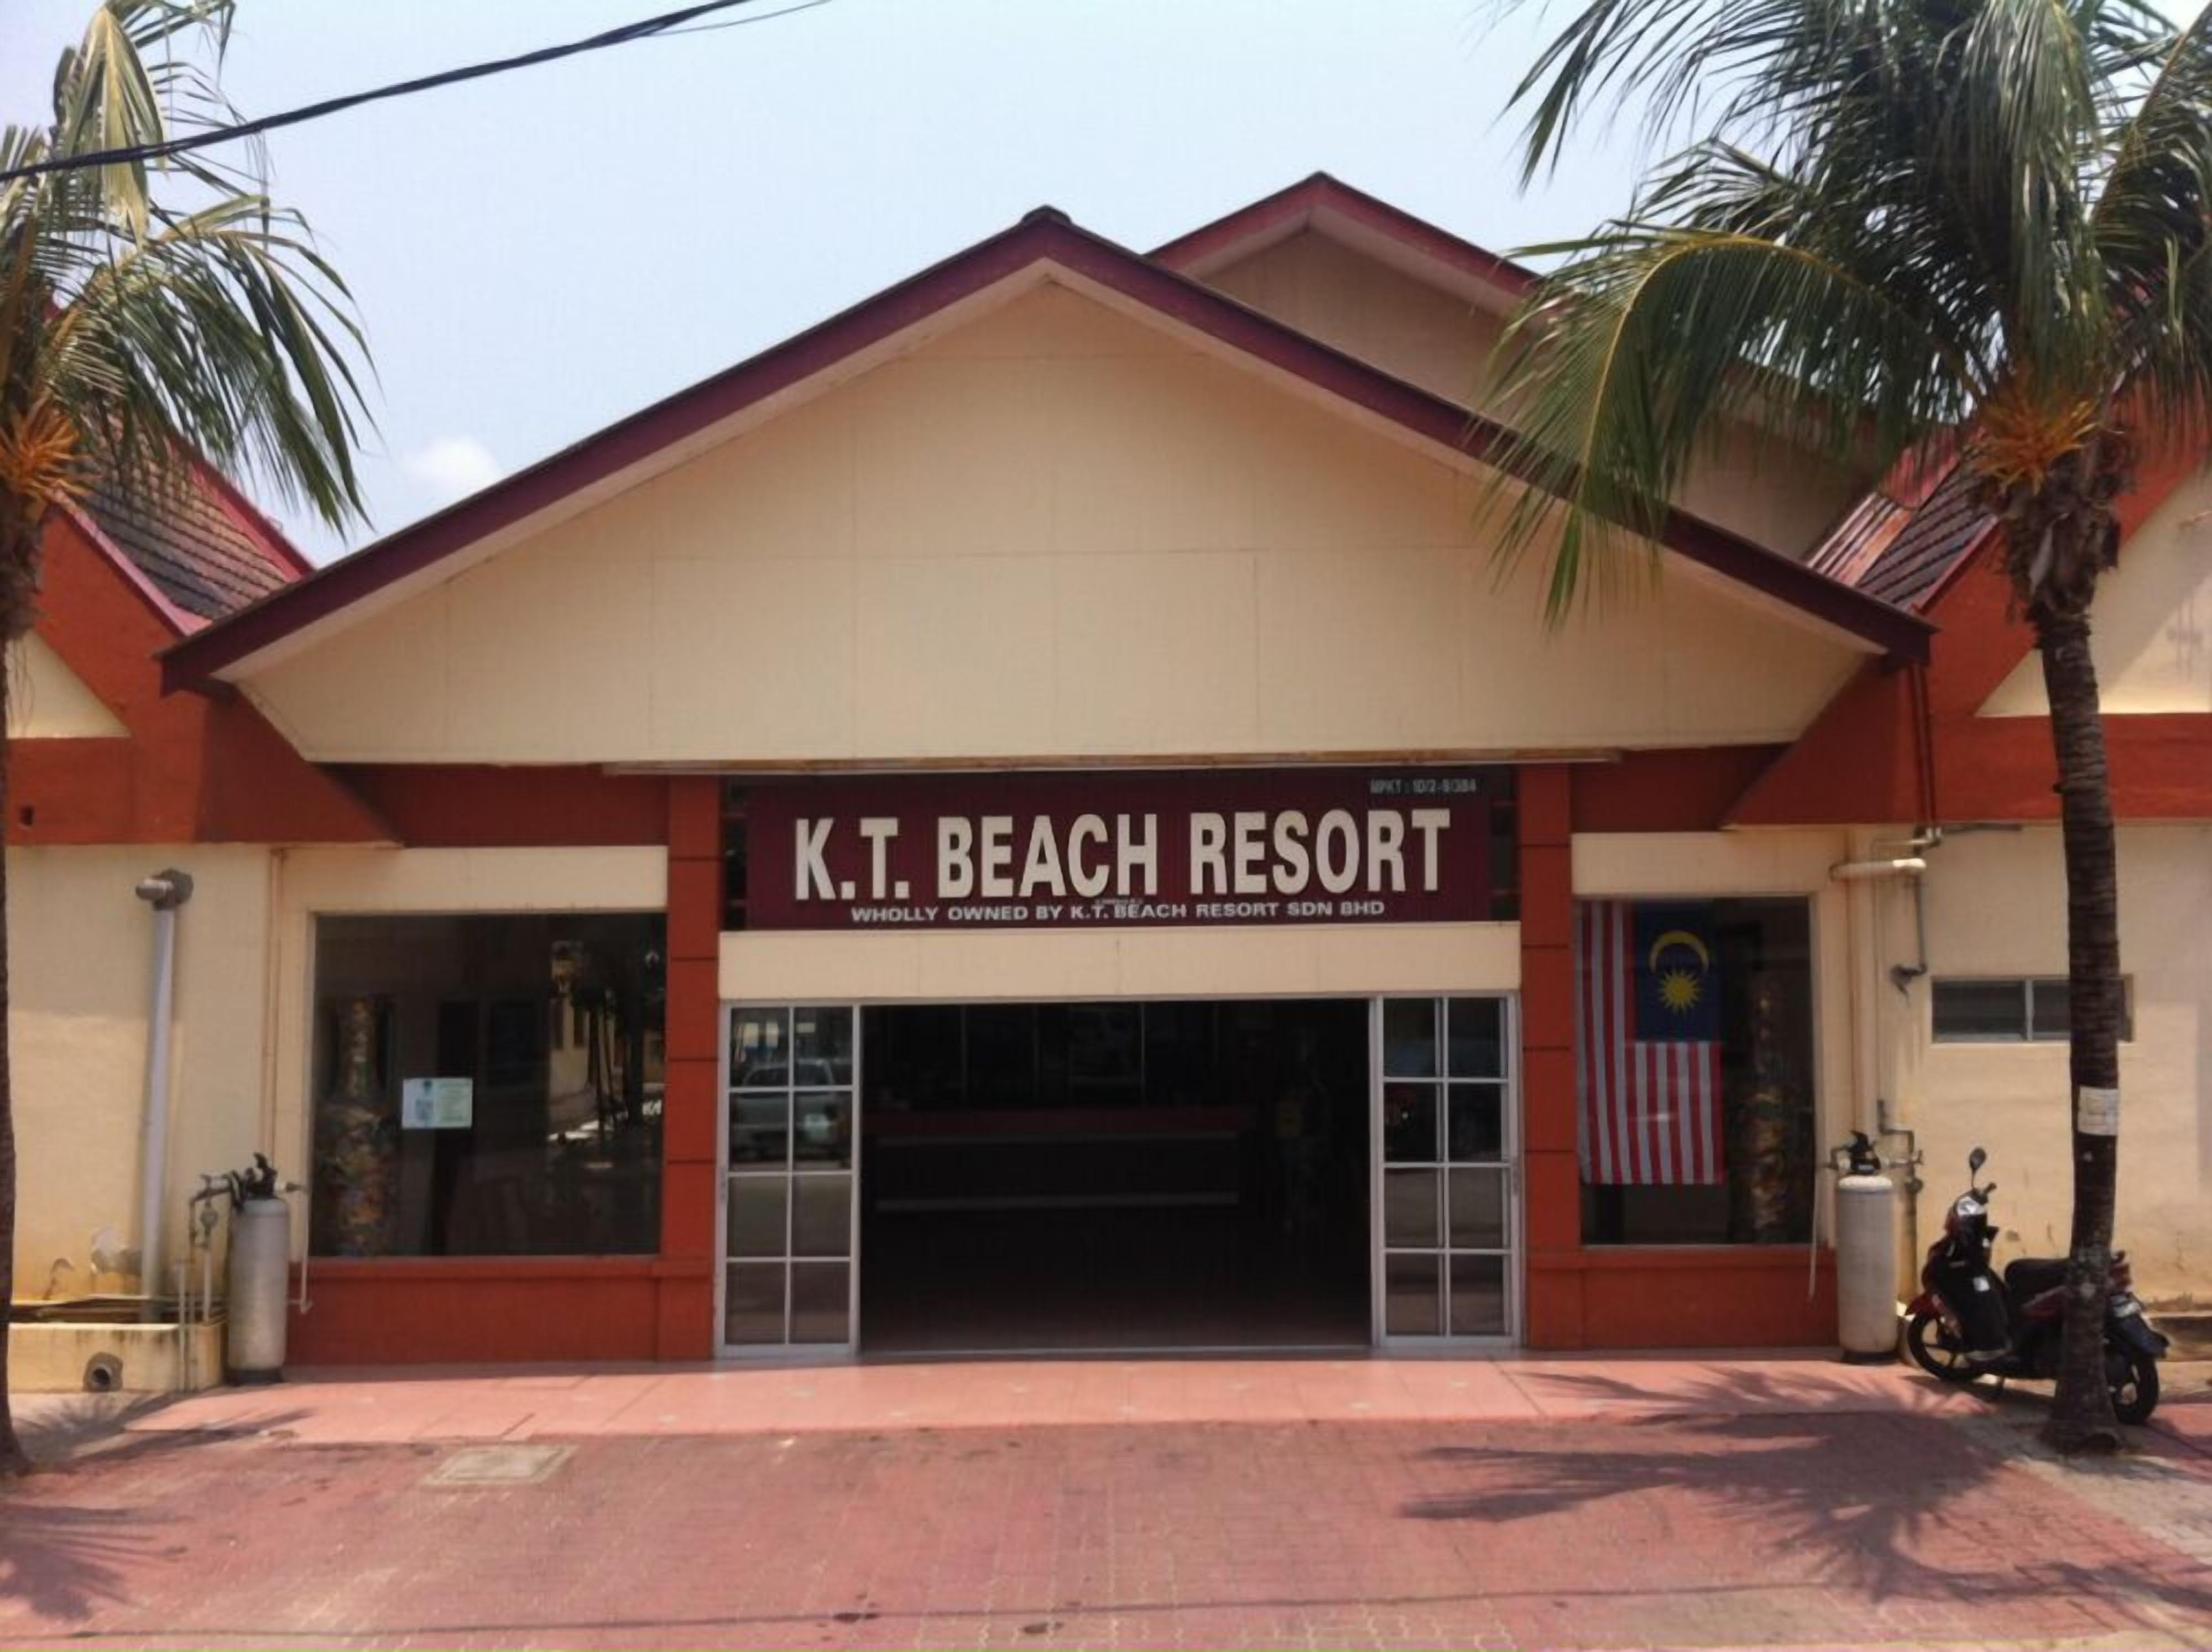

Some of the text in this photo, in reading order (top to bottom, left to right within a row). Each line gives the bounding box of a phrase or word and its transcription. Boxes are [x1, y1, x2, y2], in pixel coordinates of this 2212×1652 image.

[796, 809, 1450, 900] K.T. BEACH RESORT
[851, 901, 1385, 922] WHOLLY OWNED BY K.T. BEACH RESORT SDN BHD
